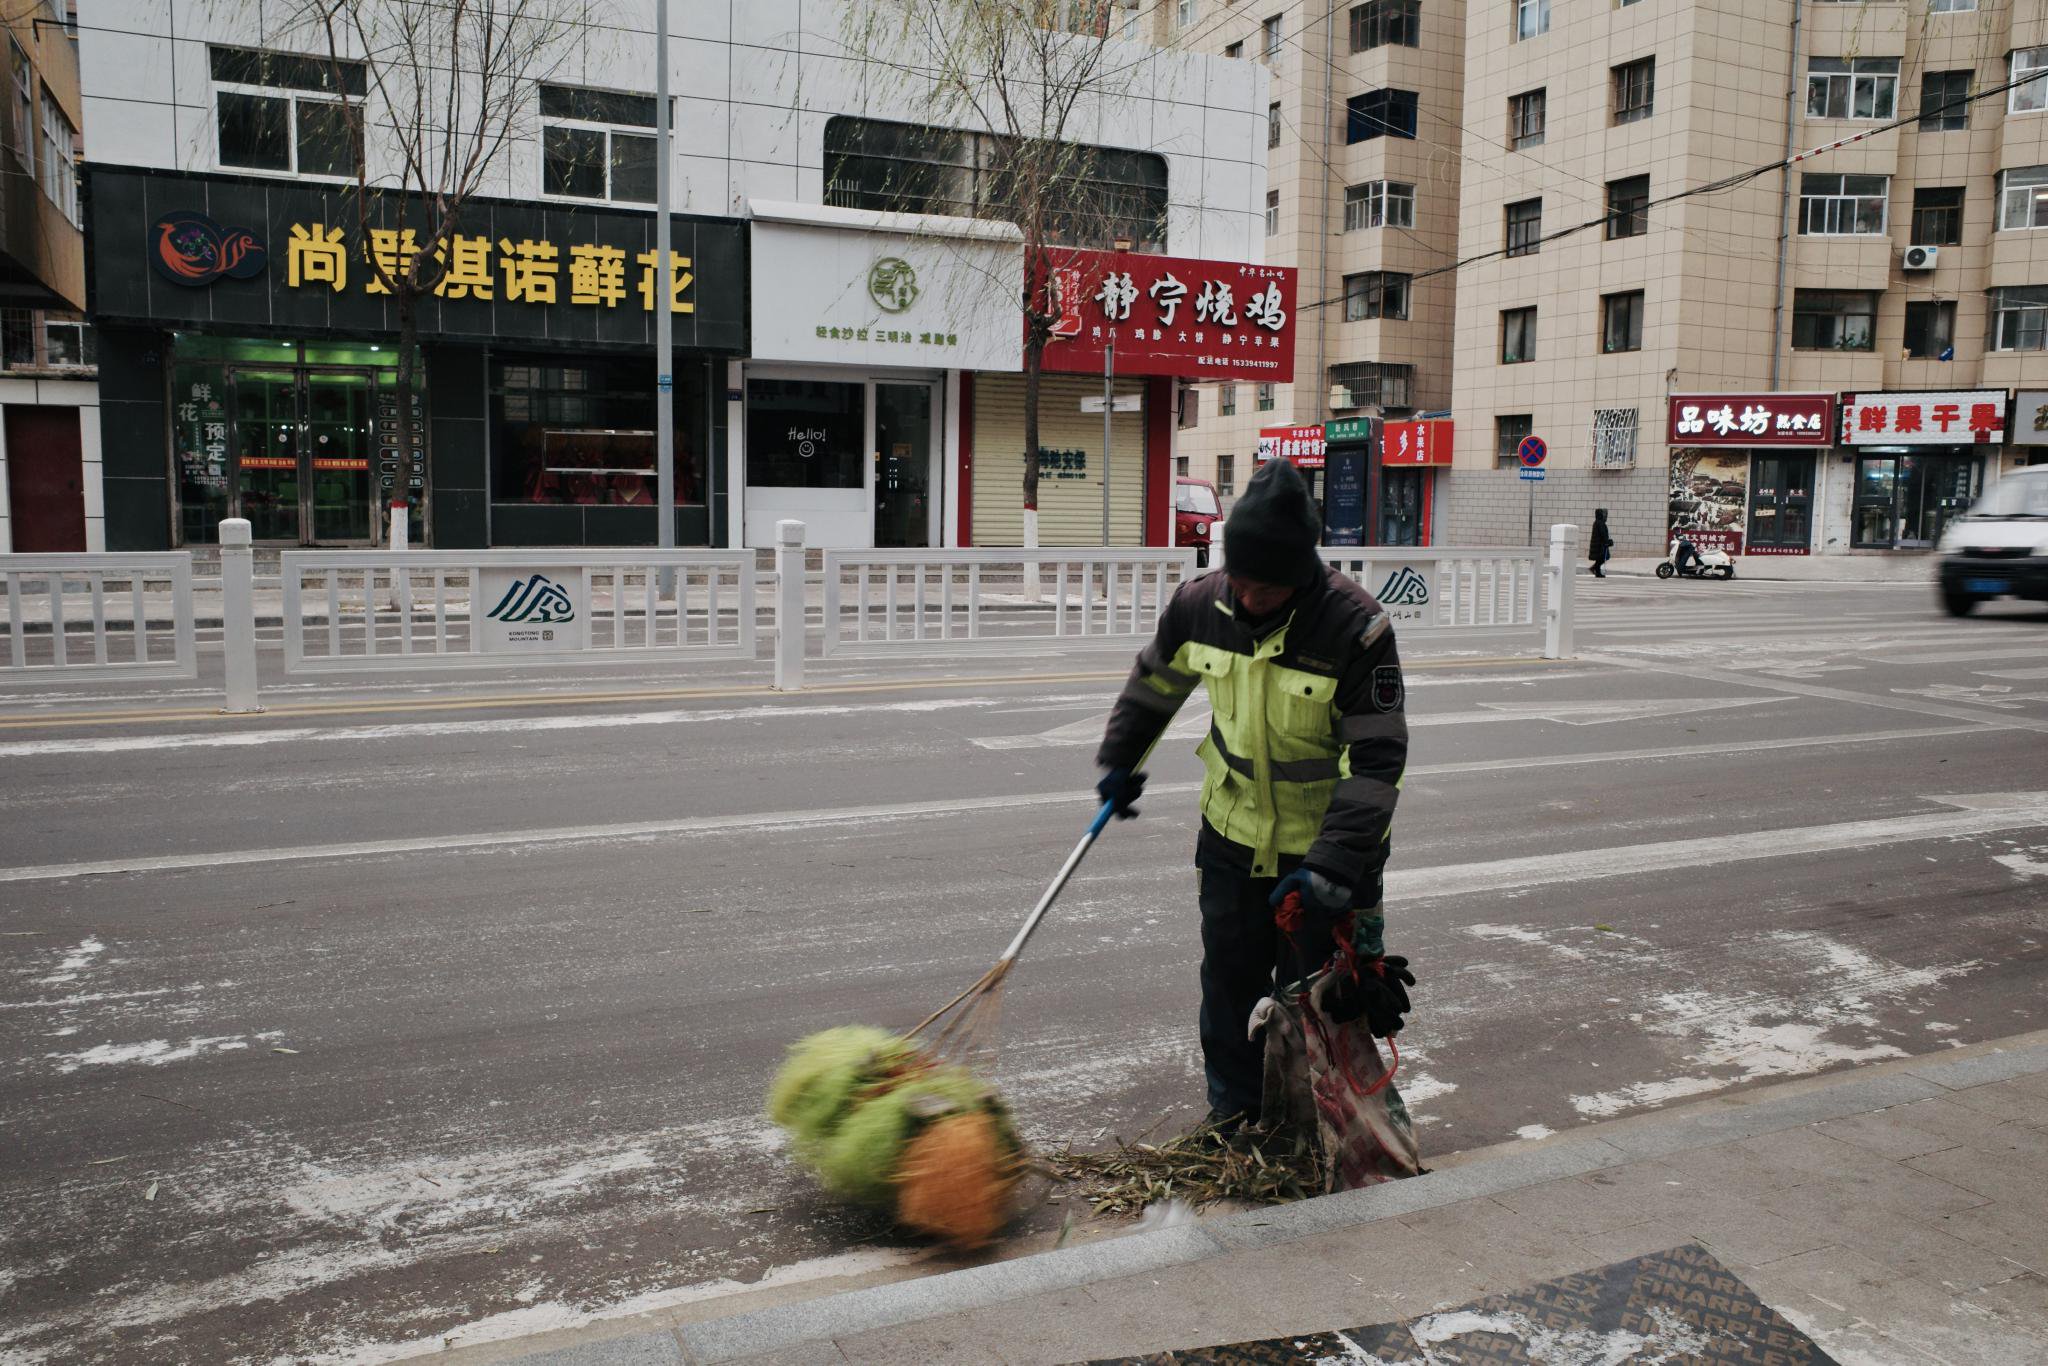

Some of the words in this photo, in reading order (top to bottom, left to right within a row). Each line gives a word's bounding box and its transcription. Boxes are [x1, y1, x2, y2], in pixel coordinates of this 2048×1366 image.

[1095, 271, 1286, 331] 静宁烧鸡
[875, 330, 912, 344] 三明治
[1222, 333, 1280, 348] 静宁苹果
[1232, 359, 1279, 369] 15339411997
[1678, 404, 1772, 436] 品味坊
[1776, 413, 1821, 430] 熟食店
[1859, 404, 1997, 433] 鲜果干果
[1416, 425, 1425, 461] 水果店
